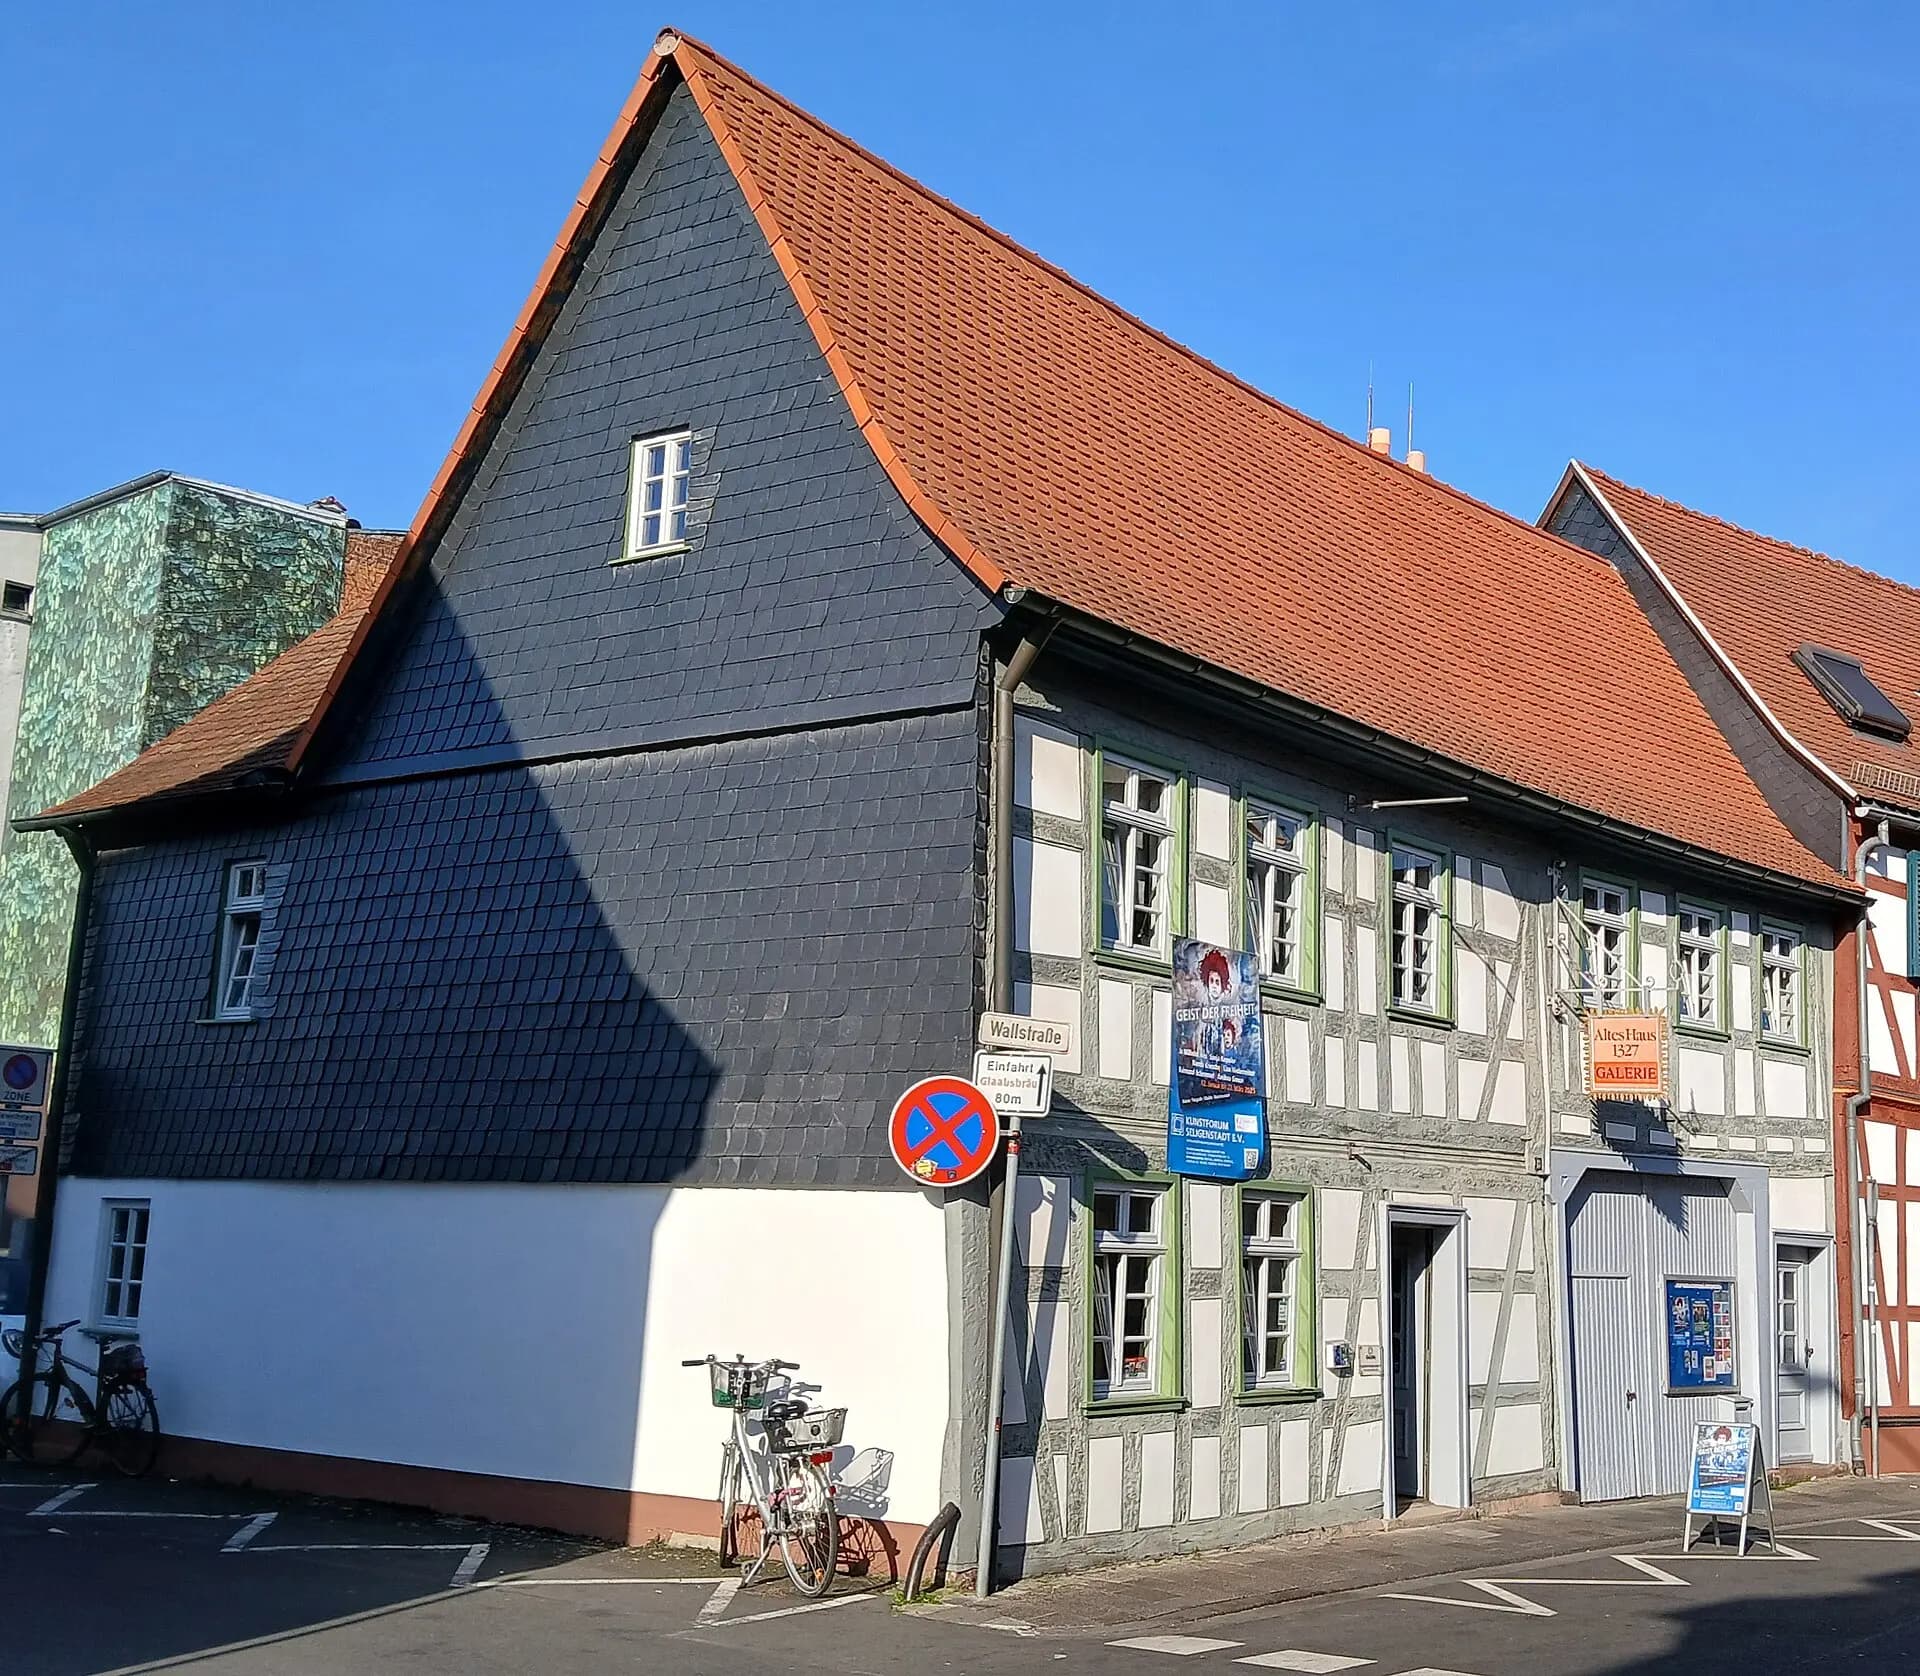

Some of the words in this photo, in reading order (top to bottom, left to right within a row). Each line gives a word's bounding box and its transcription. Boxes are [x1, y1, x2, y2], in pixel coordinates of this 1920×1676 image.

[1176, 1008, 1201, 1022] GEIST
[1201, 1005, 1220, 1019] DER
[1221, 1003, 1256, 1017] FREIHEIT
[990, 1020, 1062, 1045] Wallstraße
[1594, 1028, 1625, 1042] Altes
[1625, 1028, 1657, 1042] Haus
[1613, 1043, 1640, 1058] 1327
[987, 1060, 1034, 1074] Einfahrt
[1596, 1066, 1657, 1080] GALERIE
[980, 1076, 1038, 1089] Glaabsbräu
[4, 1091, 31, 1102] ZONE
[994, 1092, 1022, 1105] 80m
[1185, 1116, 1229, 1130] KUNSTFORUM
[1185, 1127, 1232, 1142] SELIGENSTADT
[1231, 1133, 1245, 1144] E.V.
